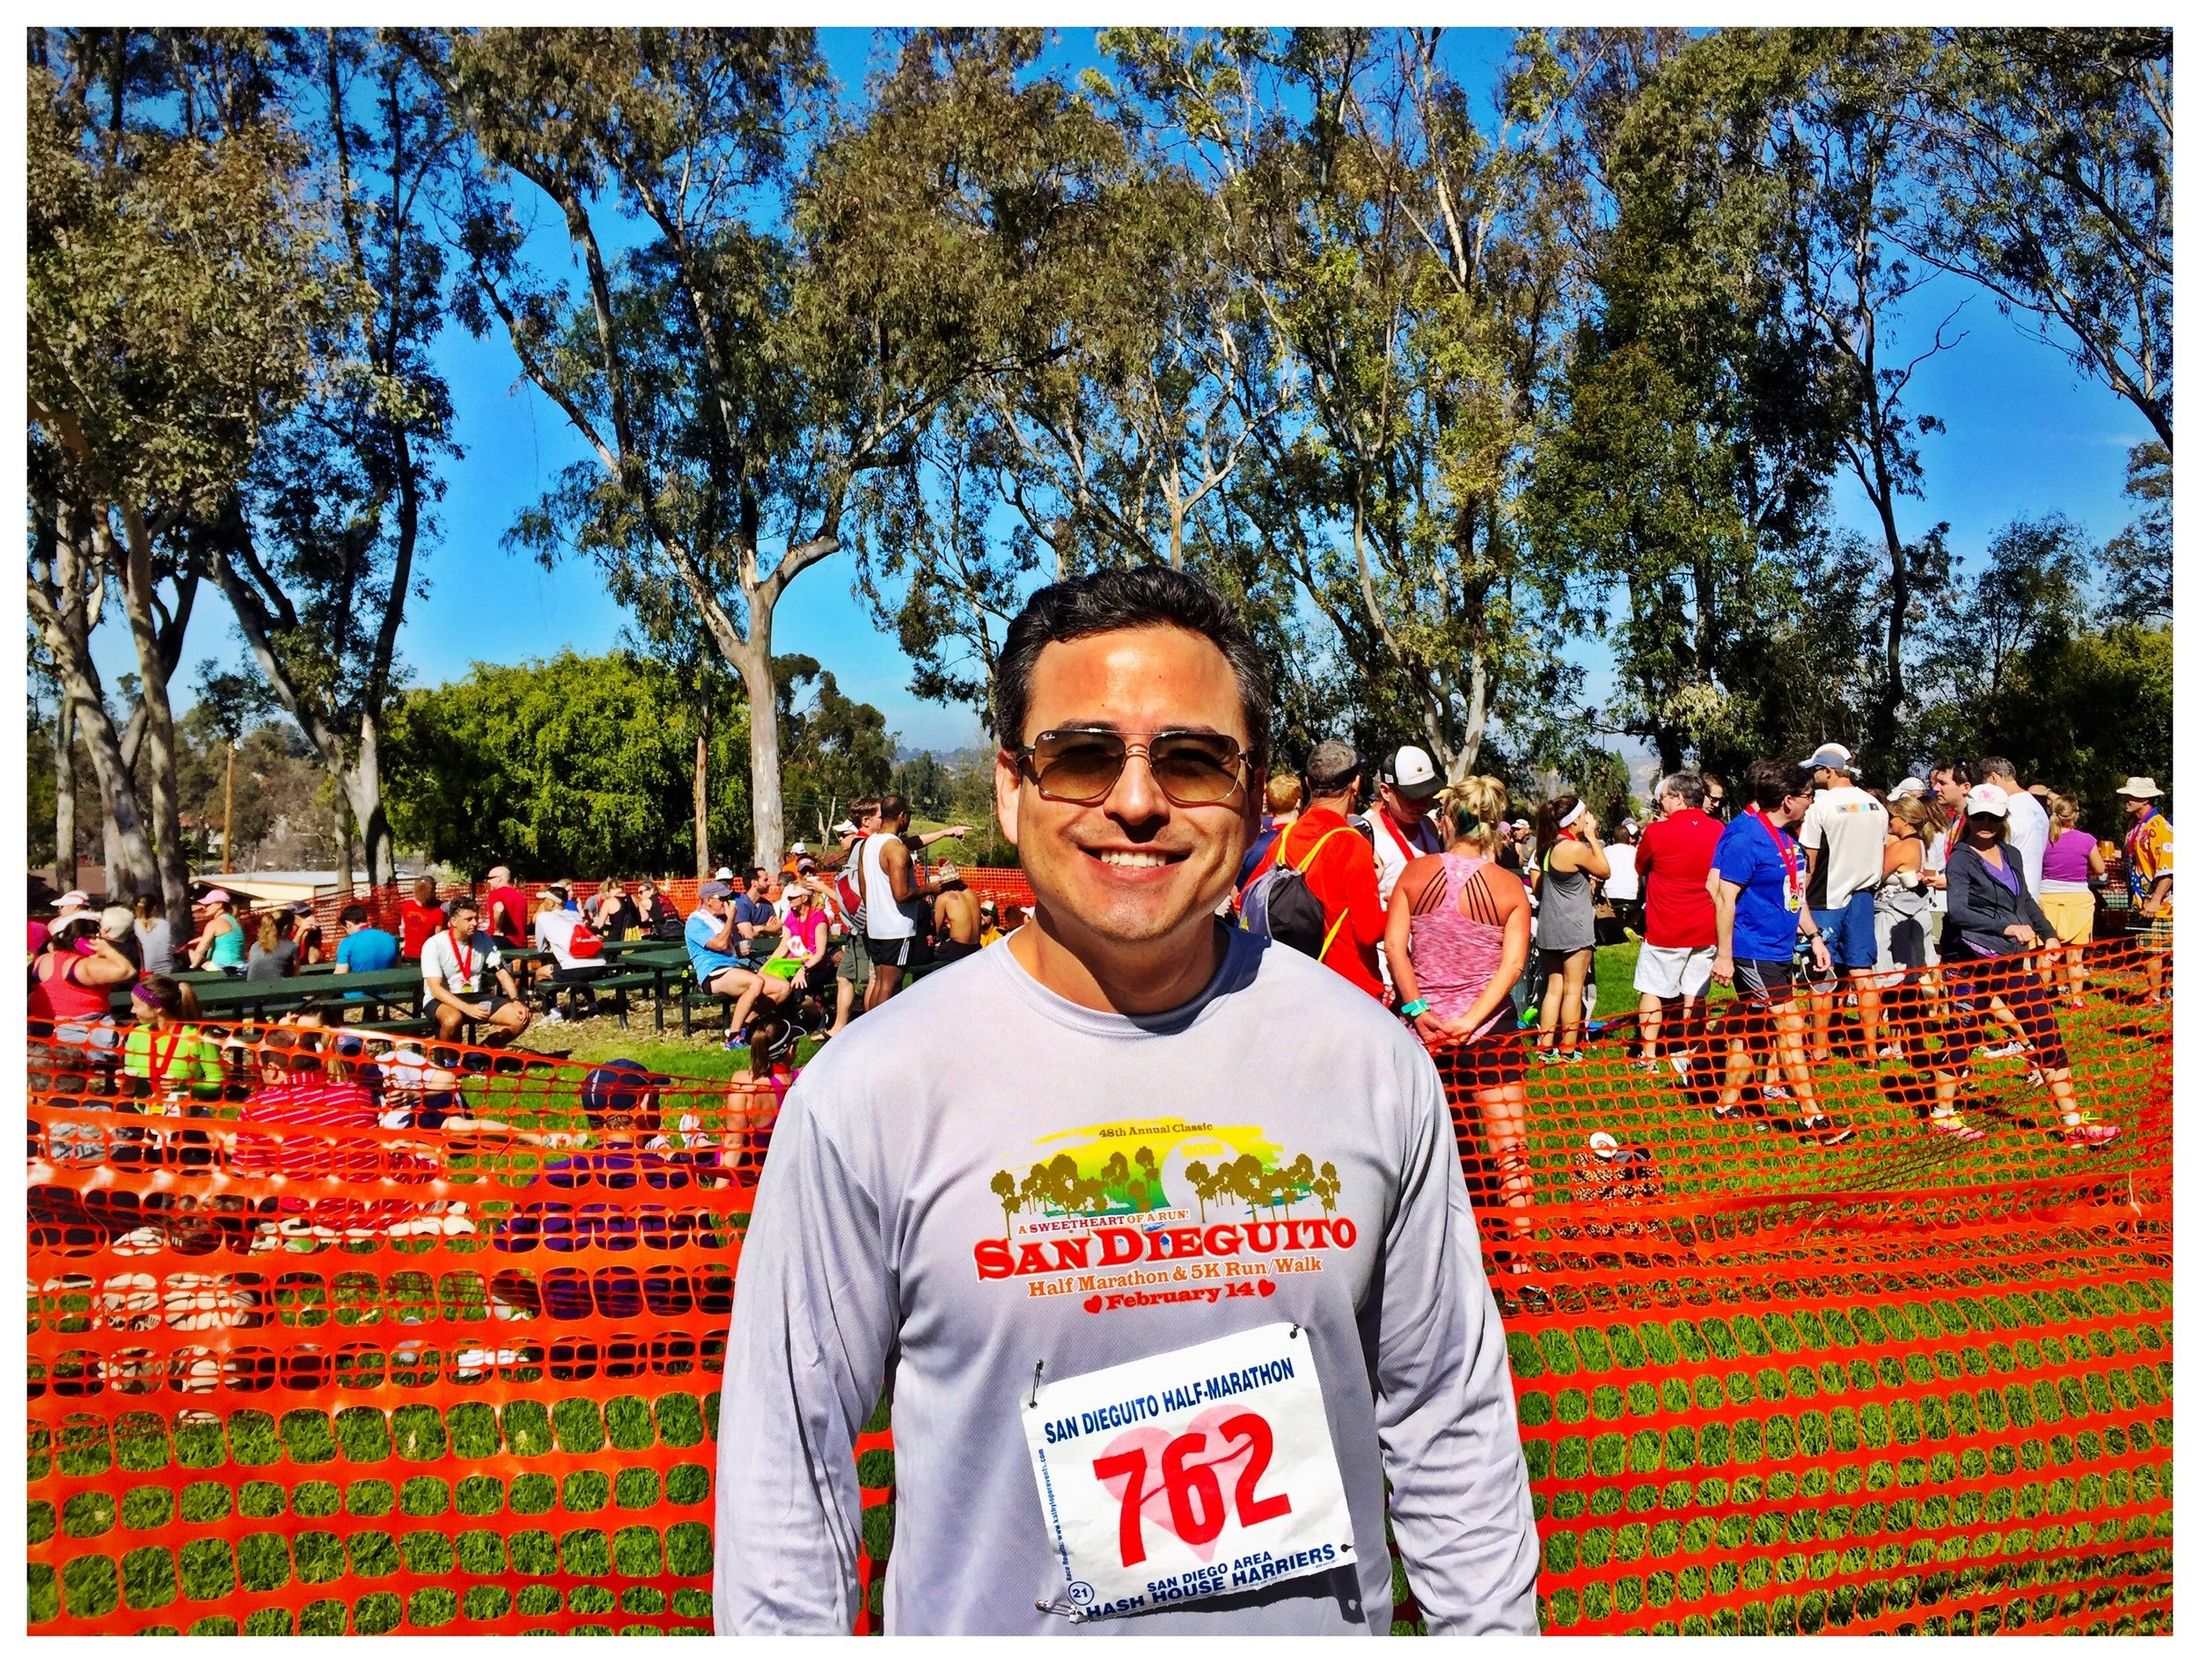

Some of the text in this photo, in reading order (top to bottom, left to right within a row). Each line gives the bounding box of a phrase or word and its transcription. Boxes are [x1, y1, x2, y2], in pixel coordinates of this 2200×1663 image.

[1099, 1122, 1213, 1138] 48th Annual Classic
[1018, 1210, 1190, 1234] A SWEETHEART OF A RUN!
[974, 1217, 1357, 1281] SAN DIEGUITO
[1028, 1277, 1073, 1297] Half
[1078, 1269, 1168, 1292] Marathon
[1172, 1265, 1187, 1281] &
[1191, 1262, 1221, 1279] 5K
[1104, 1281, 1256, 1311] February 14
[1044, 1357, 1295, 1444] SAN DIEGUITO HALF-MARATHON
[1093, 1413, 1292, 1568] 762
[1086, 1595, 1145, 1619] HASH
[1152, 1577, 1226, 1604] HOUSE
[1231, 1543, 1336, 1587] HARRIERS
[1146, 1551, 1272, 1593] SAN DIEGO AREA
[1072, 1588, 1088, 1598] 21
